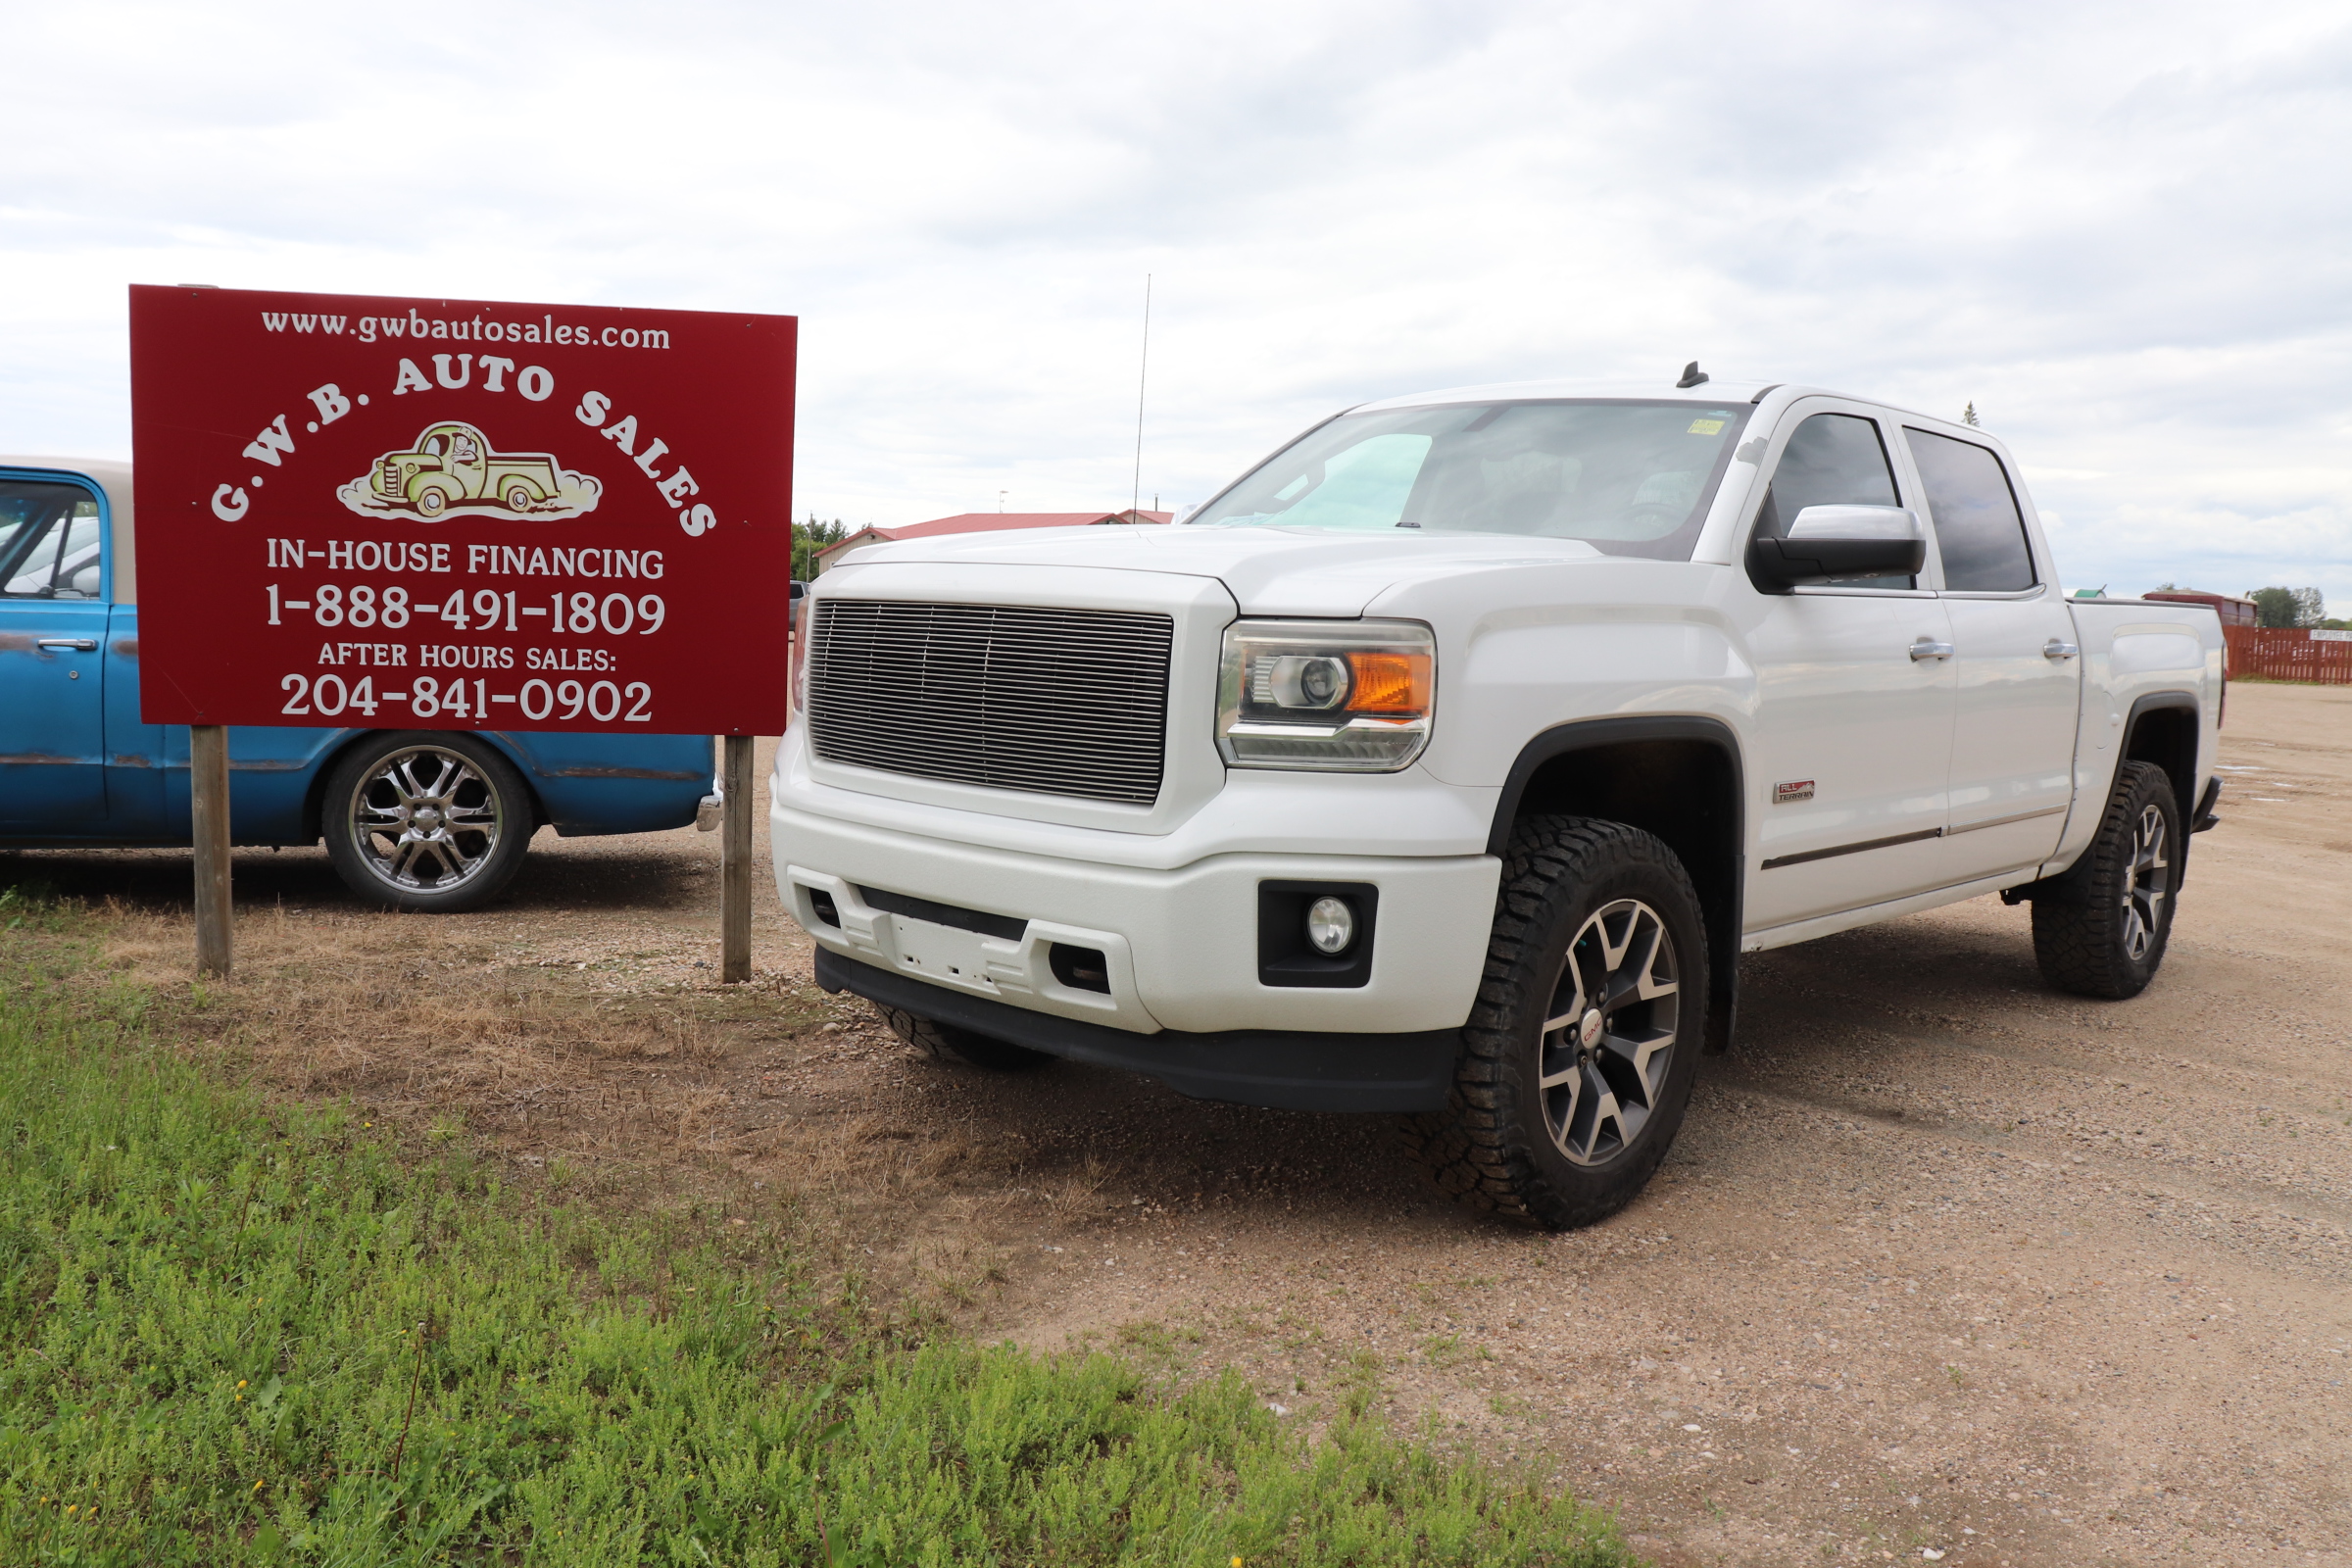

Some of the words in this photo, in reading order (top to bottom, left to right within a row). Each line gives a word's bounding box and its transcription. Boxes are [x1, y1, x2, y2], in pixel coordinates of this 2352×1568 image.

[261, 307, 670, 350] www.gwbautosales.com
[211, 382, 369, 523] G.W.B.
[392, 353, 555, 402] AUTO
[574, 390, 717, 538] SALES
[267, 538, 453, 574] IN-HOUSE
[466, 544, 664, 580] FINANCING
[266, 583, 665, 635] 1-888-491-1809
[318, 642, 408, 667] AFTER
[419, 644, 515, 670] HOURS
[525, 647, 617, 672] SALES:
[280, 673, 653, 722] 204-841-0902
[1779, 791, 1815, 802] TERRAIN
[1780, 784, 1798, 793] ALL
[1584, 1016, 1602, 1042] GMC
